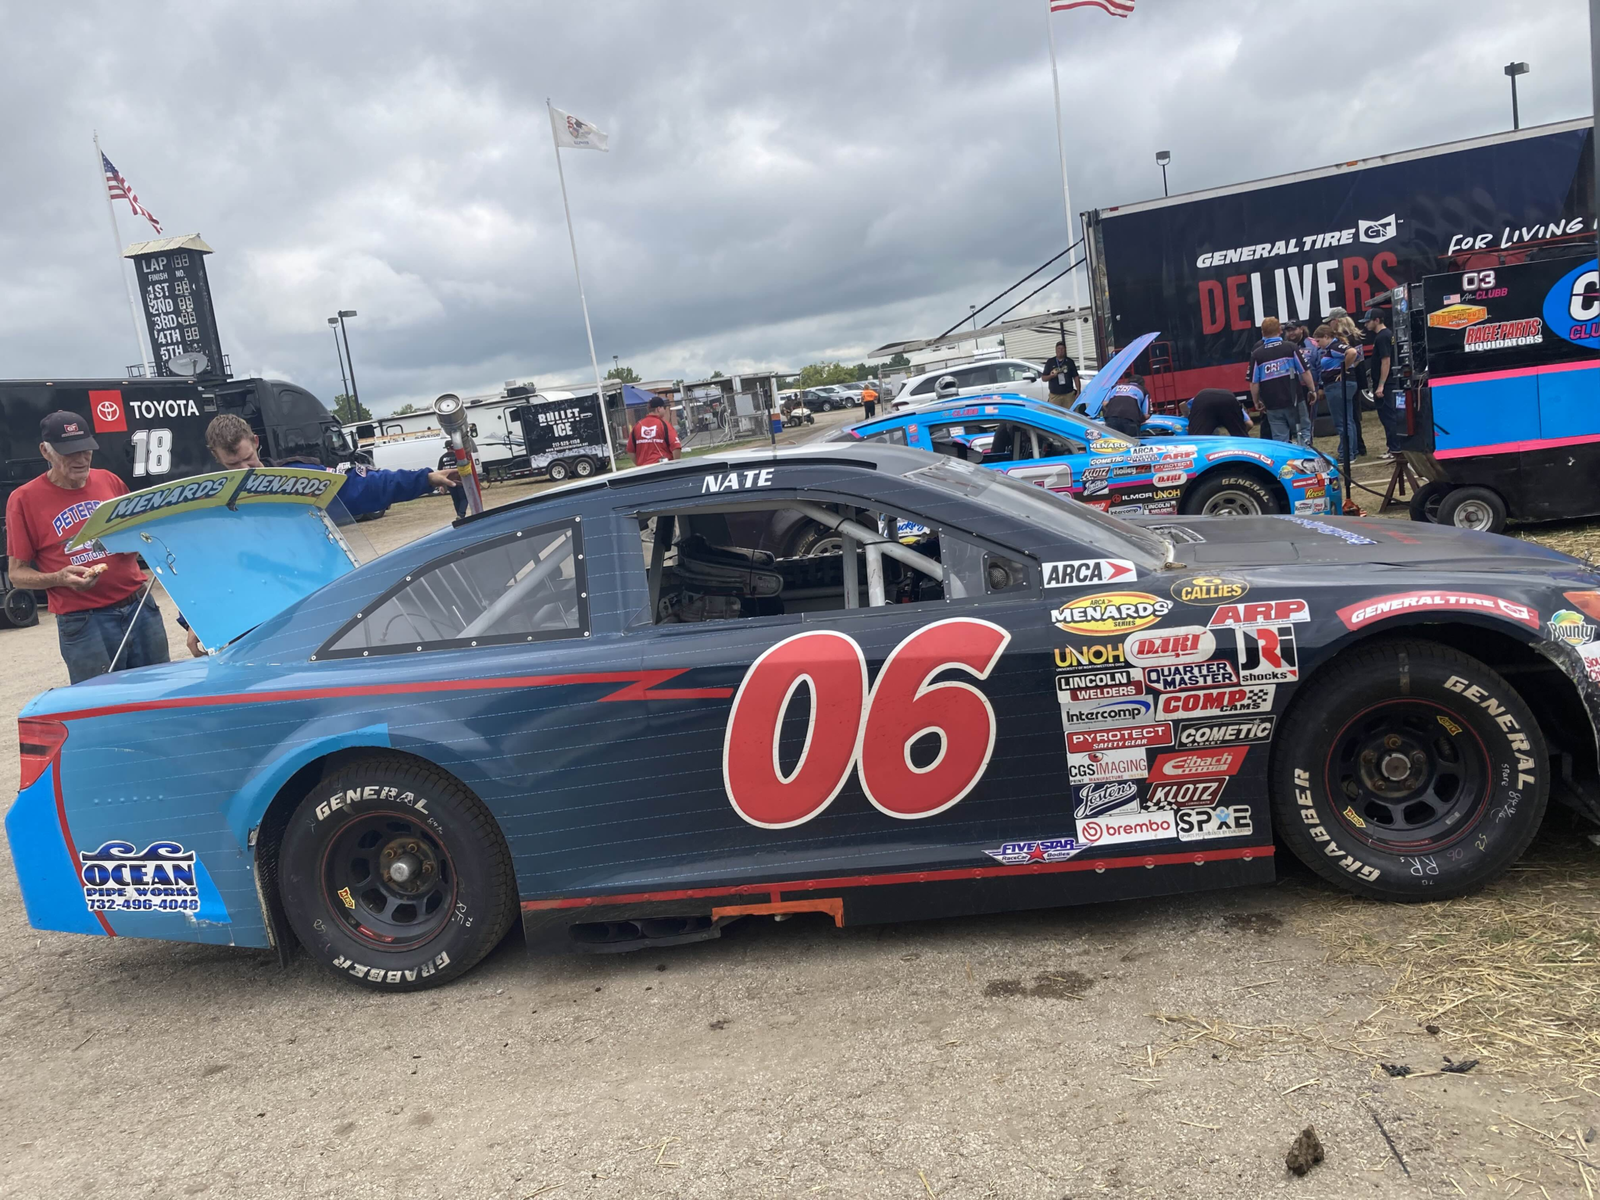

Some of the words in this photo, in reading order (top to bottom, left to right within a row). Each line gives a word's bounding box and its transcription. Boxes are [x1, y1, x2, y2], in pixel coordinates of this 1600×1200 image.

[1448, 234, 1493, 256] FOR
[1501, 217, 1583, 250] LIVING
[1196, 238, 1299, 269] GENERAL
[1302, 228, 1355, 250] TIRE
[142, 257, 167, 272] LAP
[148, 272, 168, 282] FINISH
[176, 270, 186, 278] NO.
[1462, 270, 1496, 291] 03
[148, 283, 170, 298] 1ST
[1198, 251, 1399, 335] DELIVERS
[1476, 288, 1508, 300] CLUBB
[152, 299, 174, 314] 2ND
[154, 314, 177, 330] 3RD
[1465, 325, 1500, 344] RACE
[1500, 318, 1542, 340] PARTS
[158, 329, 181, 344] 4TH
[1464, 335, 1543, 352] LIQUIDATORS
[160, 344, 184, 361] 5TH
[130, 400, 199, 419] TOYOTA
[538, 408, 580, 426] BULLET
[553, 422, 573, 437] ICE
[131, 428, 172, 478] 18
[1090, 456, 1124, 465] COMETIC
[1162, 452, 1196, 461] ARP
[1084, 467, 1109, 478] KLOTZ
[1113, 466, 1136, 475] Holley
[702, 468, 774, 494] NATE
[1222, 478, 1270, 502] GENERAL
[106, 476, 227, 523] MENARDS
[244, 474, 331, 496] MENARDS
[1122, 492, 1152, 500] ILMOR
[1154, 488, 1180, 499] UNOH
[1046, 562, 1103, 585] ARCA
[1182, 583, 1242, 600] CALLIES
[1050, 601, 1170, 623] MENARDS
[1210, 600, 1306, 625] ARP
[1351, 596, 1444, 624] GENERAL
[1446, 596, 1494, 608] TIRE
[1547, 622, 1597, 643] Bounty
[1136, 631, 1206, 656] DART
[1054, 643, 1125, 668] UNOH
[1060, 672, 1128, 690] LINCOLN
[1146, 662, 1228, 684] QUARTER
[1162, 672, 1234, 690] MASTER
[1242, 671, 1288, 682] shocks
[1076, 686, 1136, 700] WELDERS
[1162, 689, 1247, 714] COMP
[1066, 707, 1142, 722] Intercomp
[1220, 702, 1261, 712] CAMS
[722, 617, 1011, 829] 06
[1072, 726, 1166, 744] PYROTECT
[1180, 722, 1272, 744] COMETIC
[1443, 675, 1535, 790] GENERAL
[1092, 741, 1124, 750] SAFETY
[1162, 752, 1233, 775] Eibach
[1074, 782, 1137, 819] Jostens
[1152, 782, 1220, 802] KLOTZ
[315, 786, 428, 821] GENERAL
[1106, 820, 1170, 836] brembo
[1294, 768, 1381, 882] GRABBER
[1002, 842, 1037, 854] FIVE
[1040, 839, 1076, 850] STAR
[84, 864, 194, 887] OCEAN
[86, 888, 127, 897] PIPE
[133, 886, 198, 897] WORKS
[88, 899, 199, 910] 732-496-4048
[333, 951, 451, 983] GRABBER
